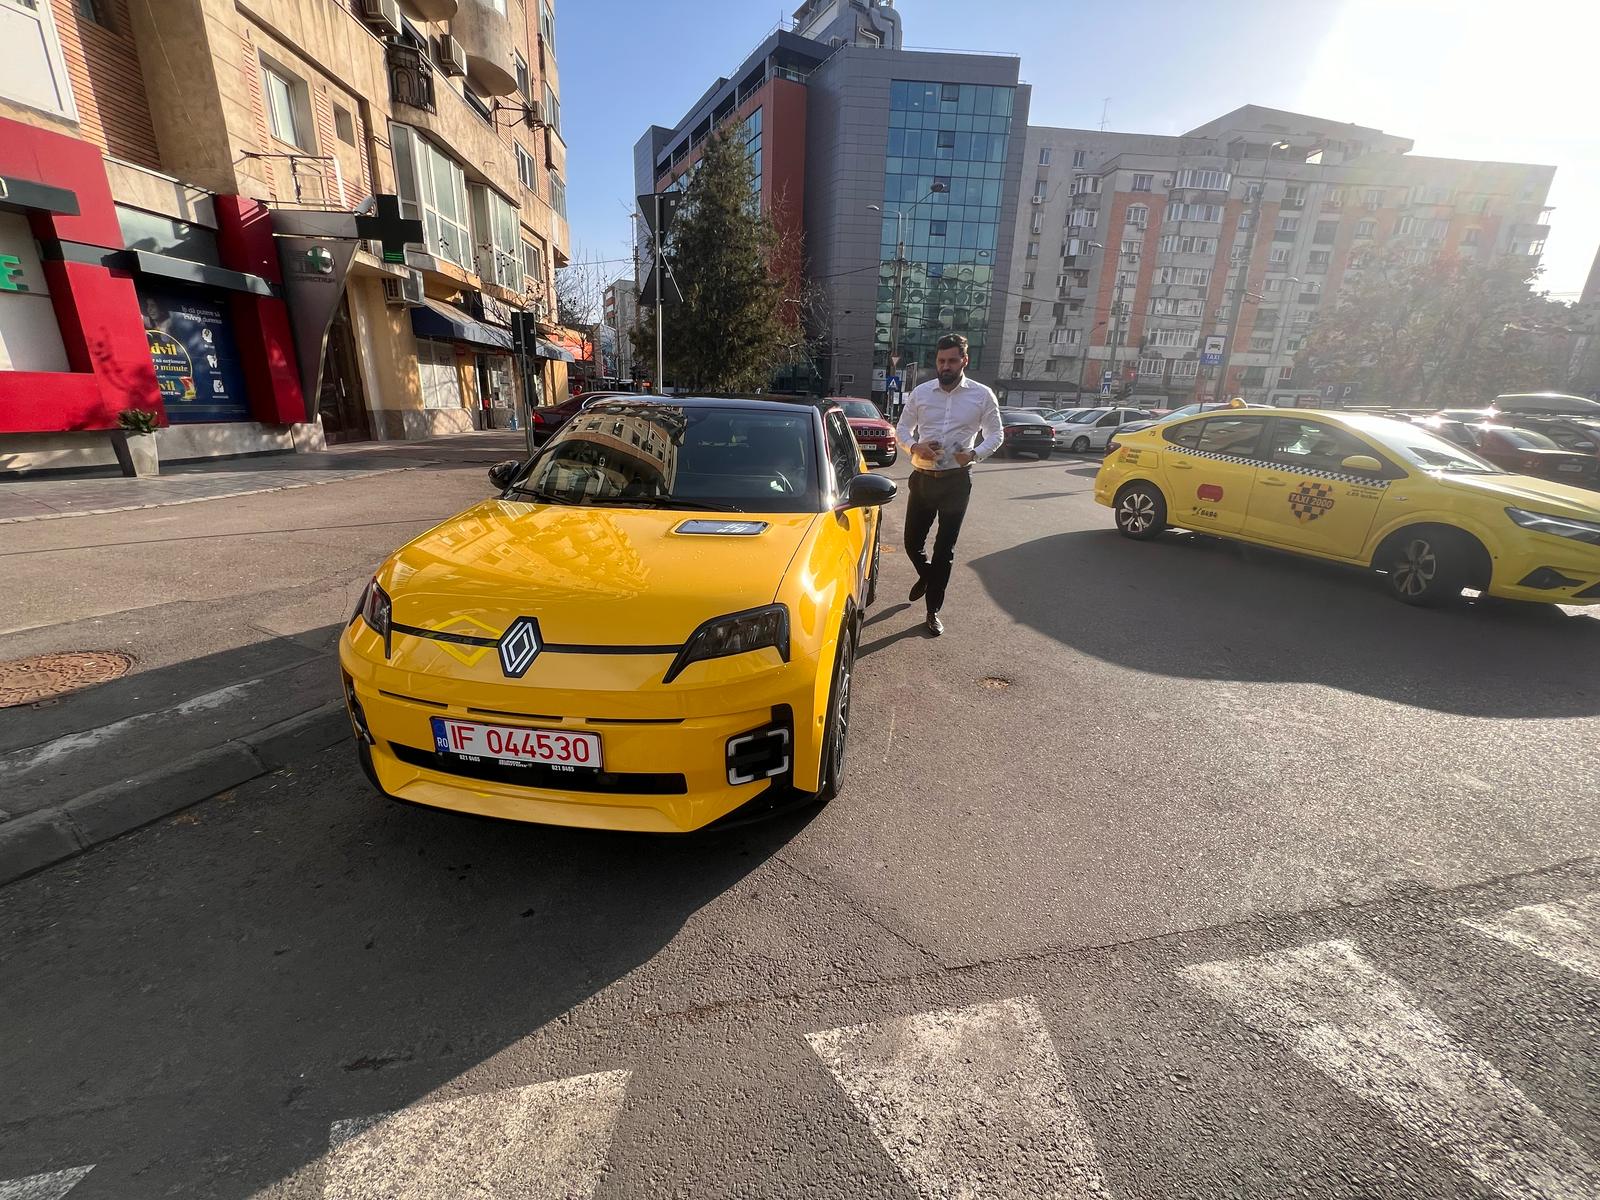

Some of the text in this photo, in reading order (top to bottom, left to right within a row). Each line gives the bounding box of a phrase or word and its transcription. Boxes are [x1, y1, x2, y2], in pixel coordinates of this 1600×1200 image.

[150, 342, 177, 356] dvil
[1290, 493, 1334, 509] TAXI 2000
[437, 737, 449, 748] RO
[450, 725, 590, 763] IF 044530
